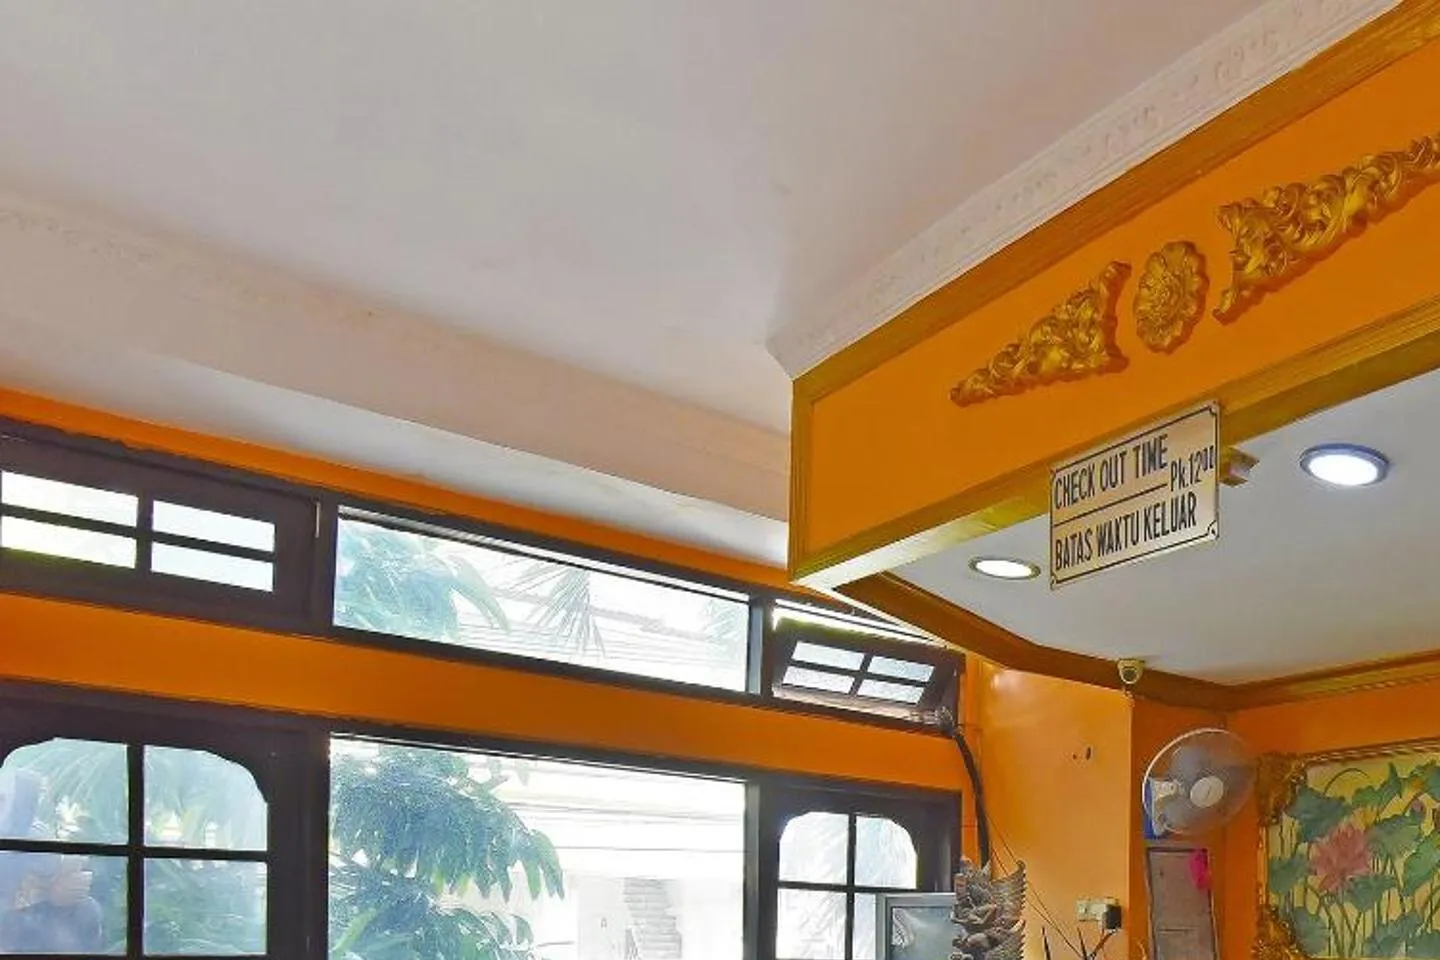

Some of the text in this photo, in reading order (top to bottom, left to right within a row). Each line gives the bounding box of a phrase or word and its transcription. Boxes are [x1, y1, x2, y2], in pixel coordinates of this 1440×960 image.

[1054, 434, 1168, 509] CHECK OUT TIME
[1055, 492, 1197, 571] BATAS WAKTU KELUAR
